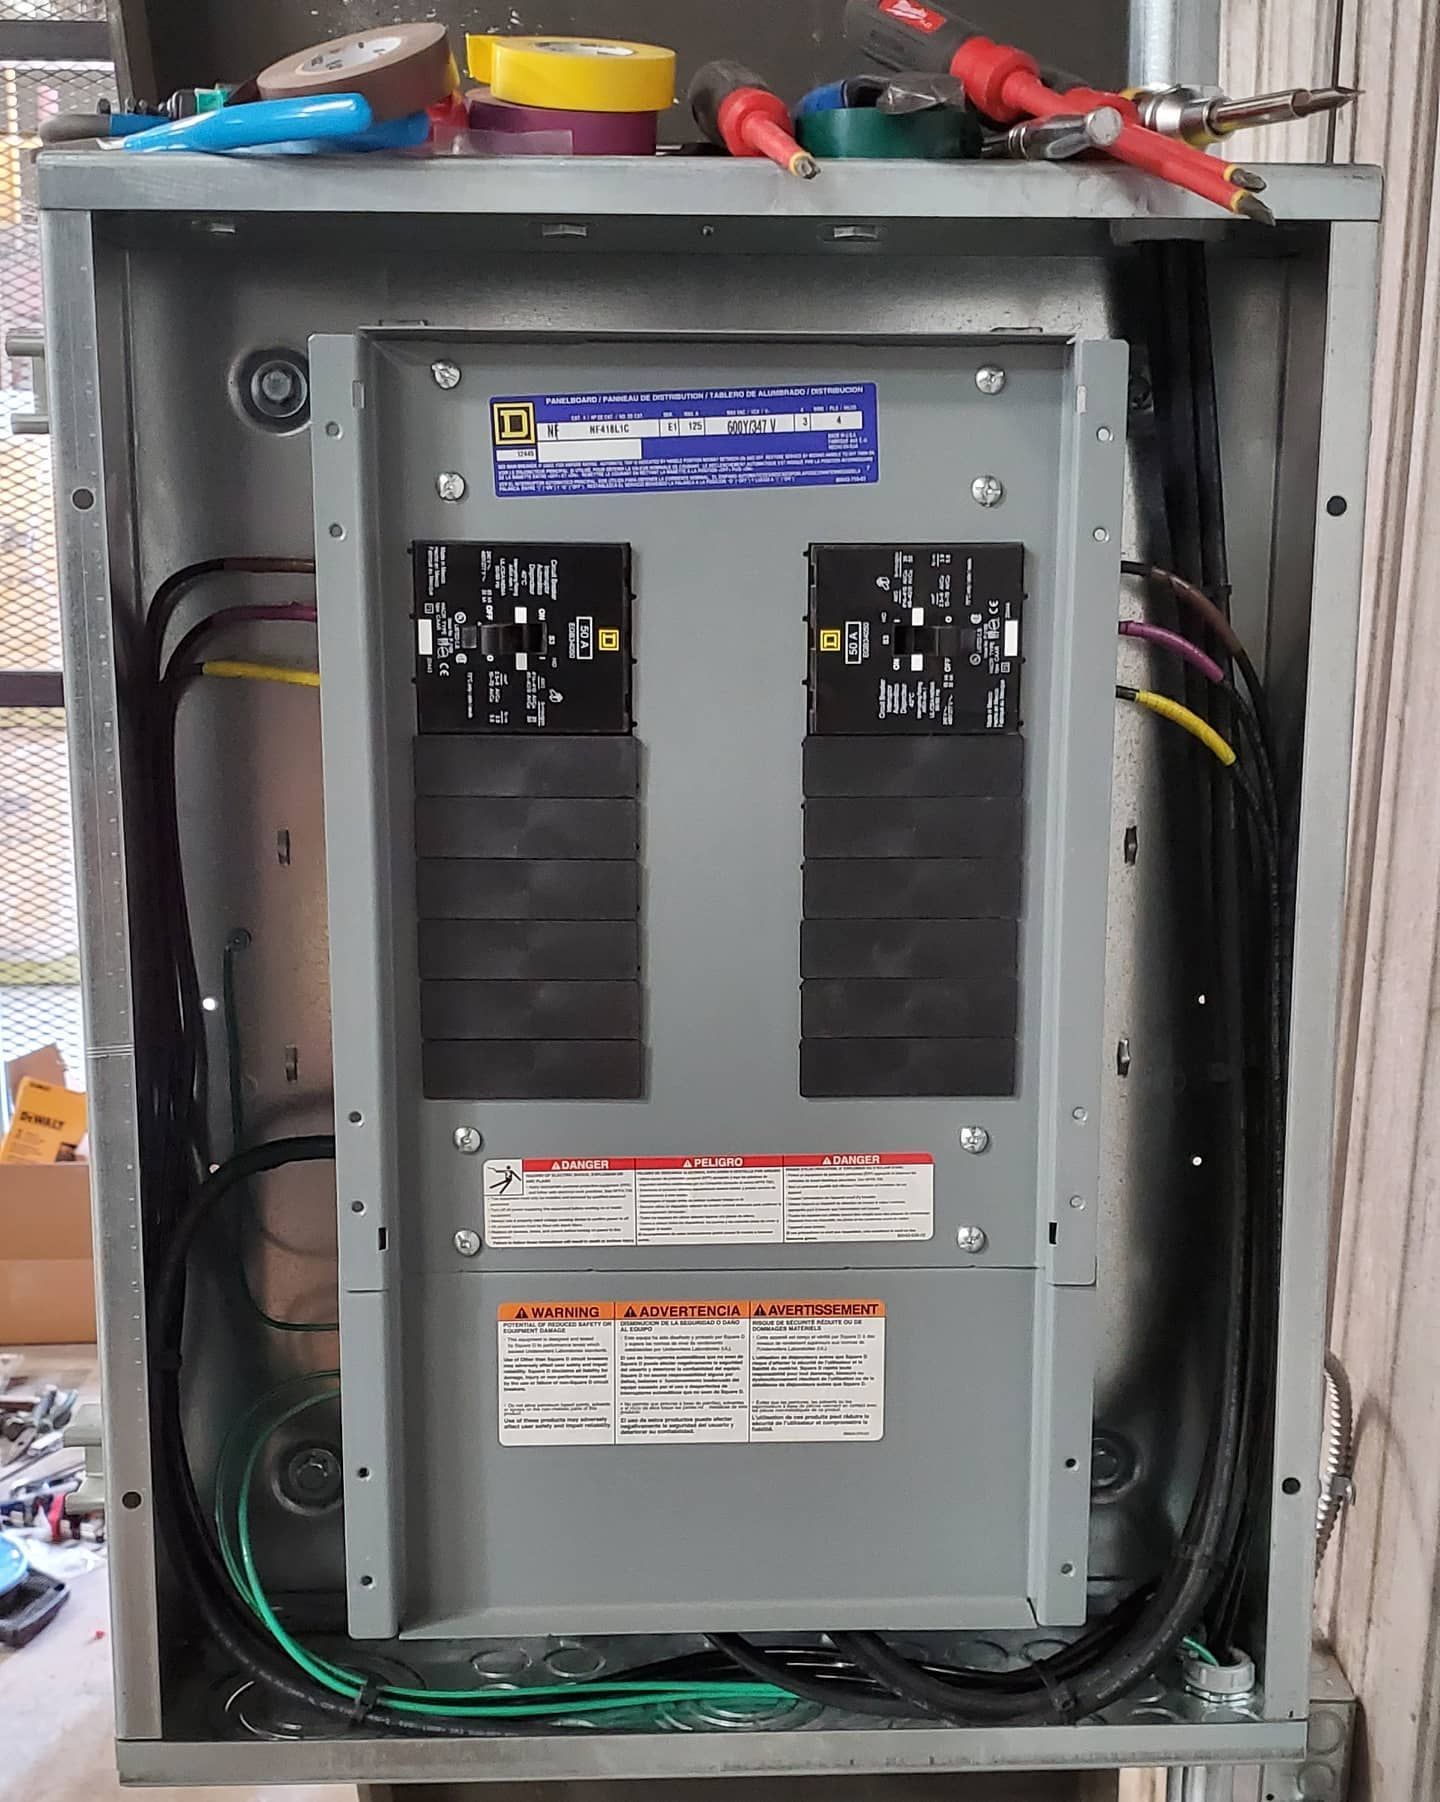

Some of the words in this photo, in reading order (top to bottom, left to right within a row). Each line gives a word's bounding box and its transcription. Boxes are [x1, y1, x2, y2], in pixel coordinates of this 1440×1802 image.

[546, 396, 597, 405] PANELBOARD
[603, 395, 638, 404] PANNEAU
[641, 394, 651, 402] DE
[652, 392, 704, 402] DISTRIBUTION
[710, 391, 744, 400] TABLERO
[758, 388, 805, 398] ALUMBRADO
[547, 424, 559, 440] NF
[688, 422, 702, 432] 125
[728, 420, 766, 434] 600Y/347
[770, 419, 776, 432] V
[803, 417, 808, 426] 3
[836, 416, 842, 424] 4
[486, 604, 494, 620] OFF
[538, 608, 546, 620] ON
[580, 626, 589, 638] 50
[848, 632, 858, 640] A
[580, 640, 589, 648] A
[848, 642, 858, 656] 50
[893, 658, 900, 670] ON
[561, 1160, 609, 1170] DANGER
[694, 1158, 743, 1167] PELIGRO
[833, 1155, 880, 1164] DANGER
[532, 1307, 600, 1318] WARNING
[640, 1305, 740, 1317] ADVERTENCIA
[768, 1304, 878, 1315] AVERTISSEMENT
